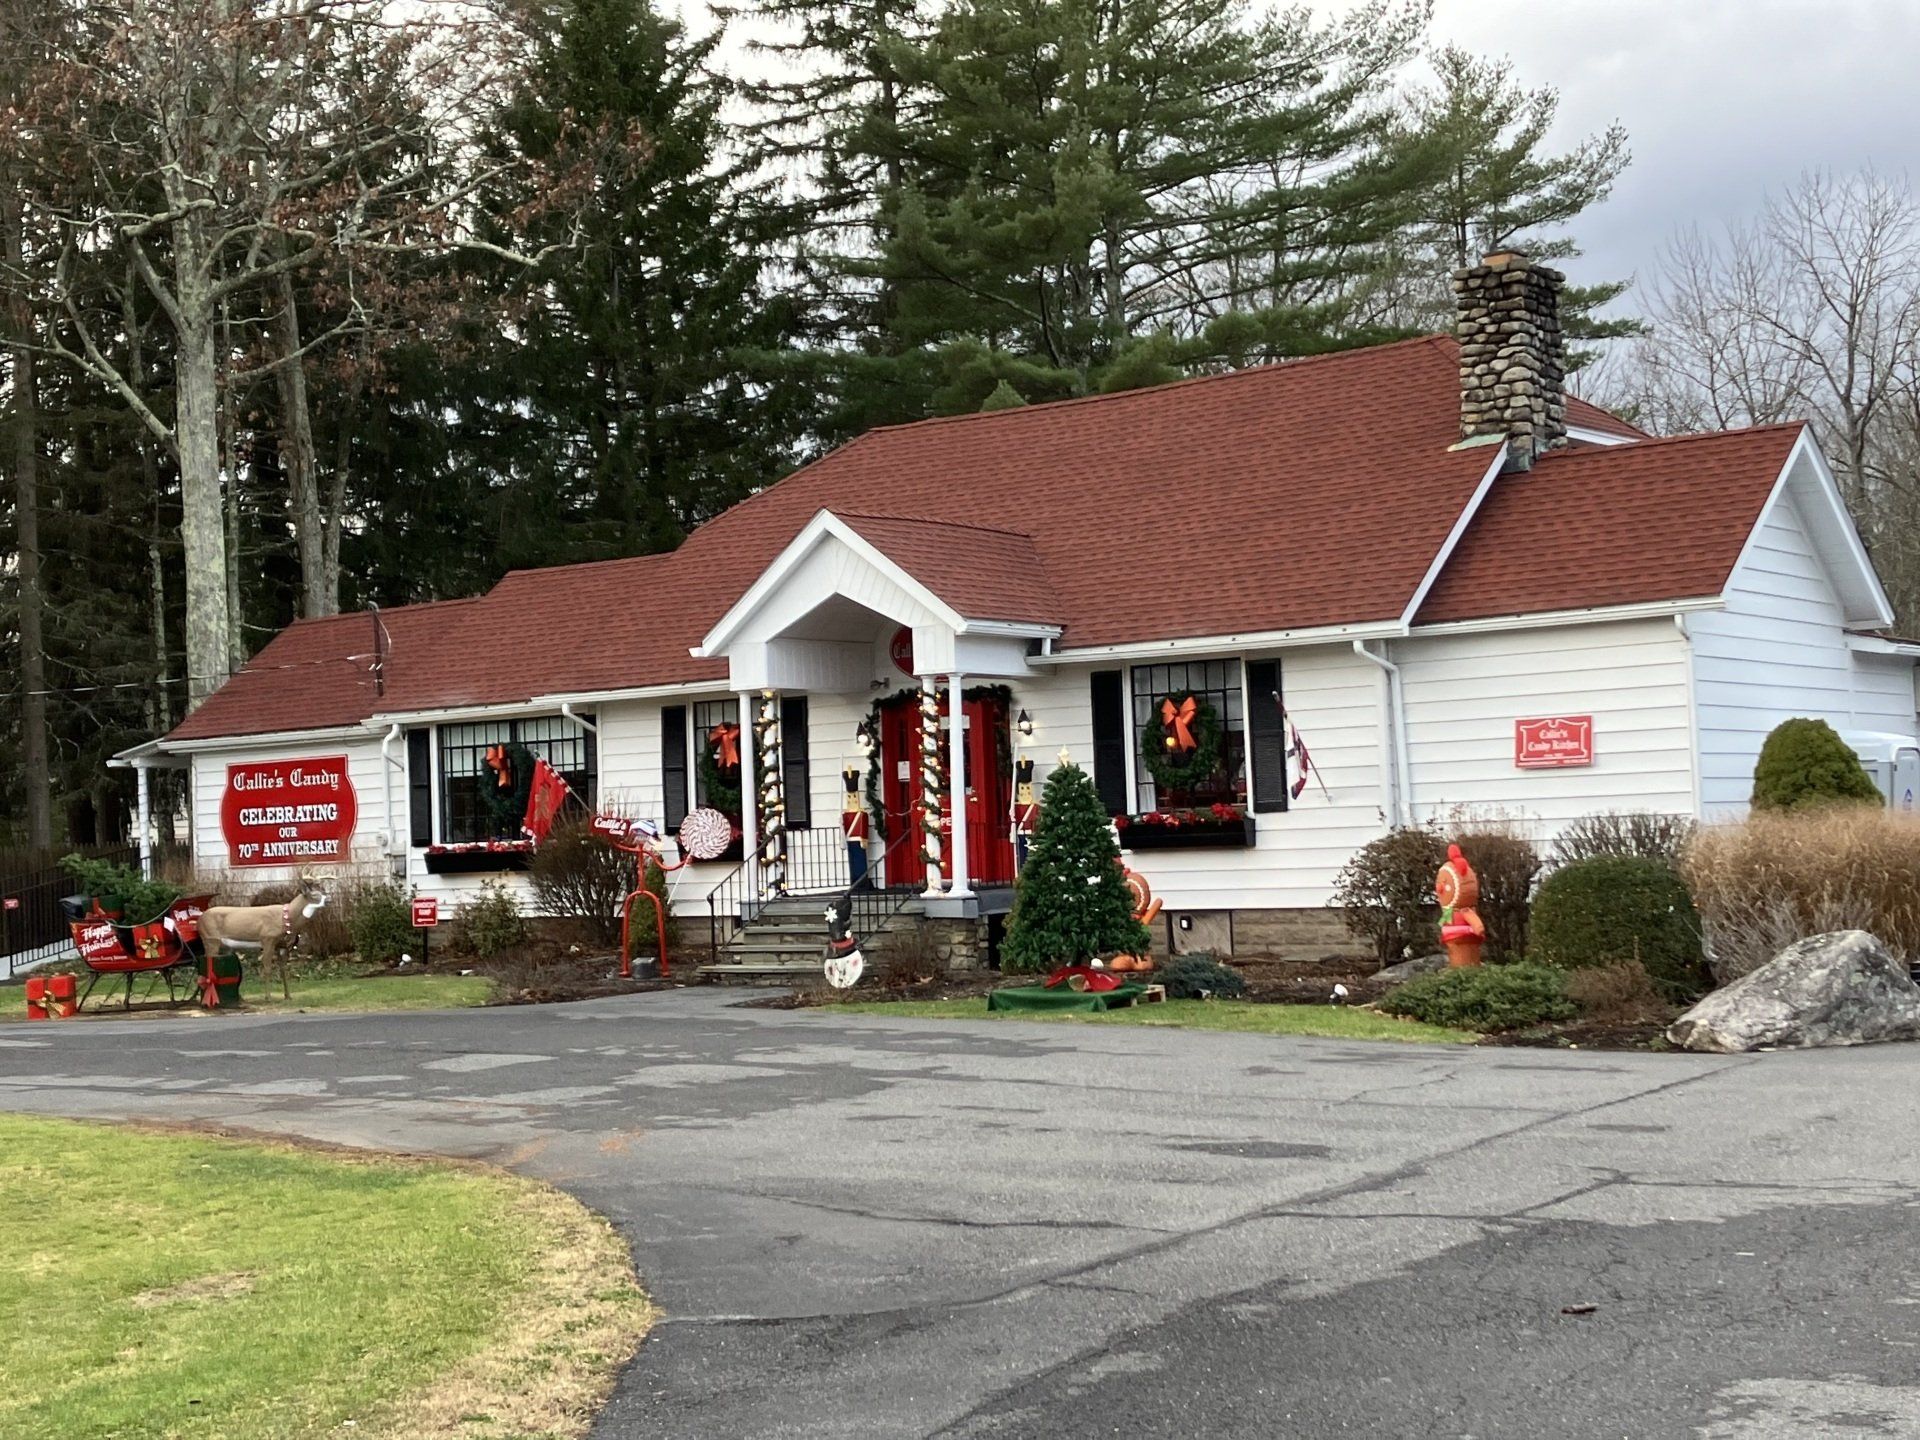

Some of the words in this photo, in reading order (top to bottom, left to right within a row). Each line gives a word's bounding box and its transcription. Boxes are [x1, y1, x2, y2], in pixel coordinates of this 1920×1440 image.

[233, 769, 283, 791] Callie's
[290, 768, 339, 791] Candy
[239, 803, 338, 826] CELEBRATING
[279, 827, 298, 838] OUR
[594, 818, 627, 831] Callie's
[262, 840, 340, 857] ANNIVERSARY
[80, 922, 113, 941] Happy
[79, 935, 118, 956] Holidays
